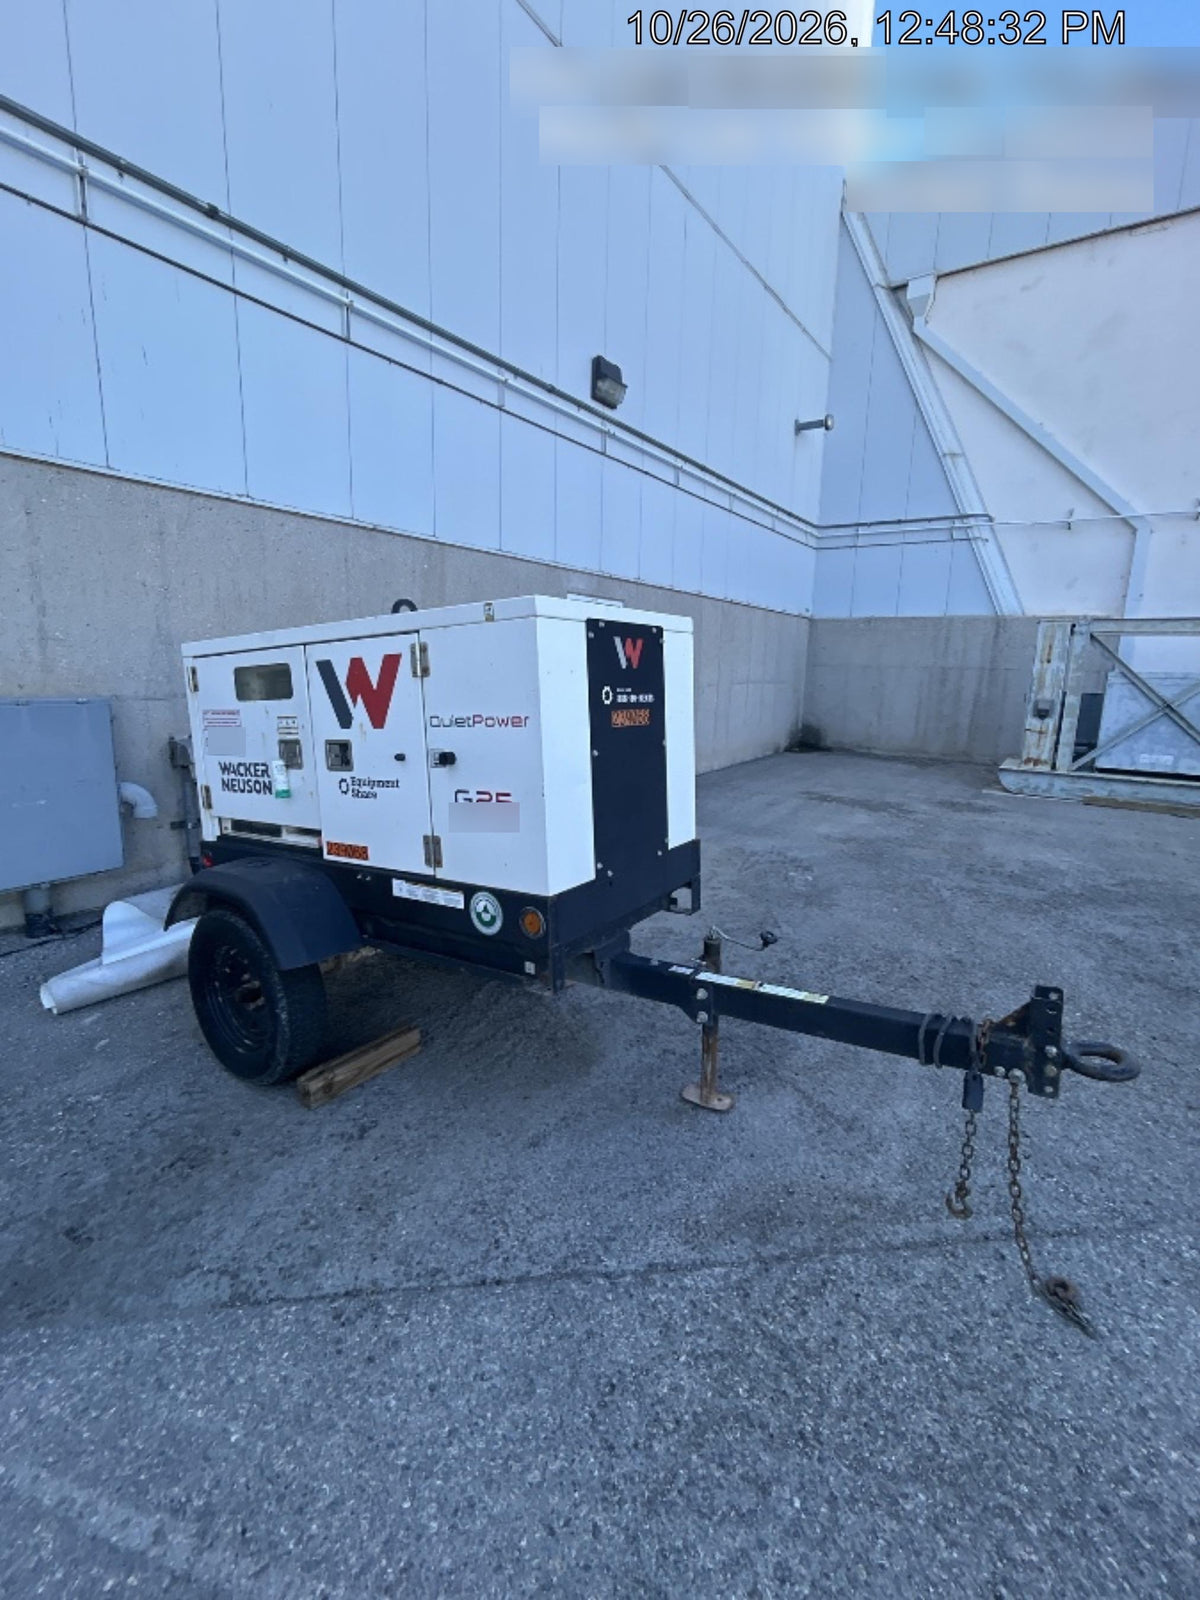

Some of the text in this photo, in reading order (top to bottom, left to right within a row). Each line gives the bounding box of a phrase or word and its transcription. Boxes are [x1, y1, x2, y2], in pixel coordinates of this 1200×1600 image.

[429, 714, 529, 728] QuietPower
[218, 761, 271, 779] WACKER
[221, 777, 273, 796] NEUSON
[350, 776, 400, 790] Equipment
